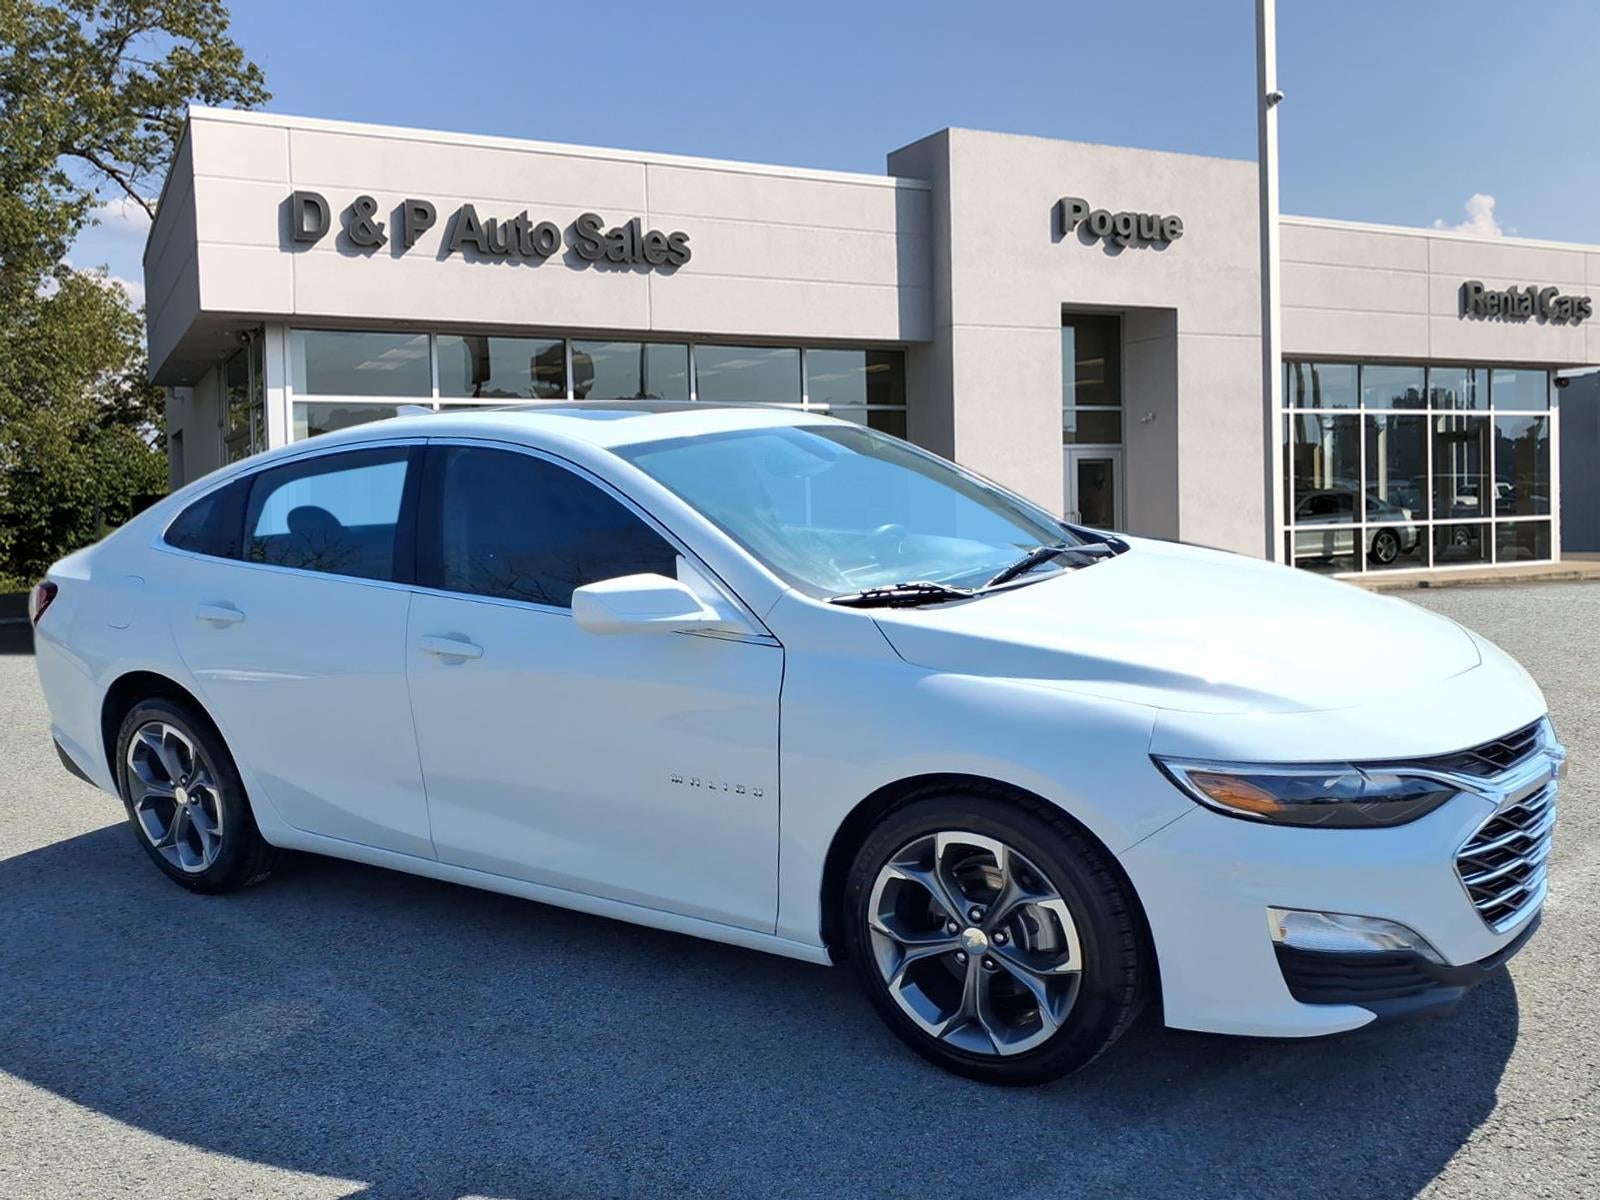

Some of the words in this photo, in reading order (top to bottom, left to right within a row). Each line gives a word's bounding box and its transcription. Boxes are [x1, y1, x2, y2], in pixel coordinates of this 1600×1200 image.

[286, 191, 331, 248] D
[342, 196, 388, 252] &
[397, 199, 438, 252] P
[444, 204, 562, 261] Auto
[569, 213, 692, 269] Sales
[1056, 197, 1184, 250] Pogue
[1461, 280, 1539, 321] Rental
[1538, 286, 1593, 324] Cars
